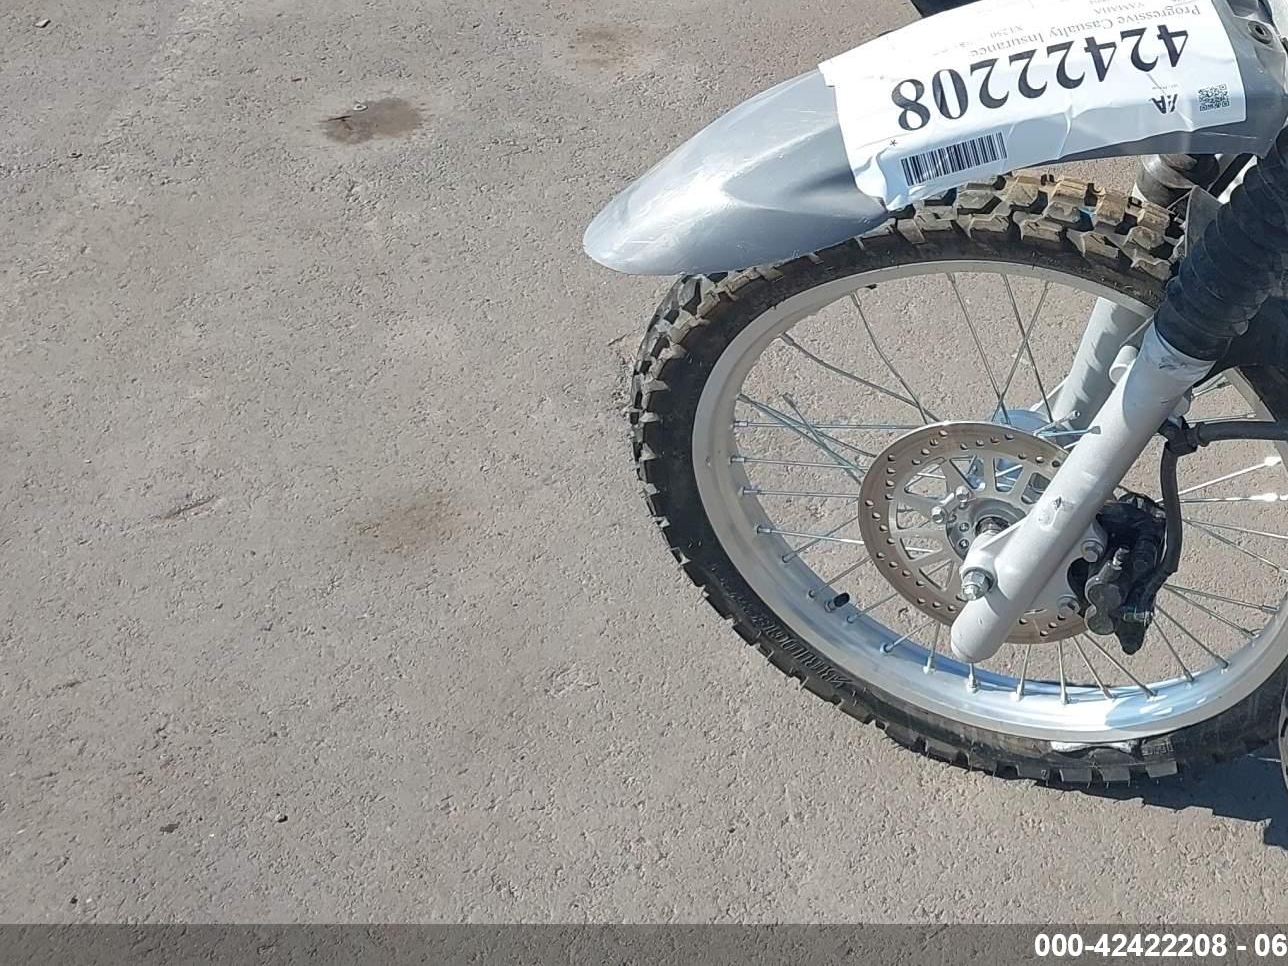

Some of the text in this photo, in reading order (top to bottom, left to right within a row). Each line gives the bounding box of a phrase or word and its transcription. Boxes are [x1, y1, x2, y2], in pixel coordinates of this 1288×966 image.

[1117, 4, 1201, 27] Progressive
[1049, 18, 1114, 38] Casualty
[969, 32, 1045, 58] Insurance
[891, 24, 1189, 131] 42422208
